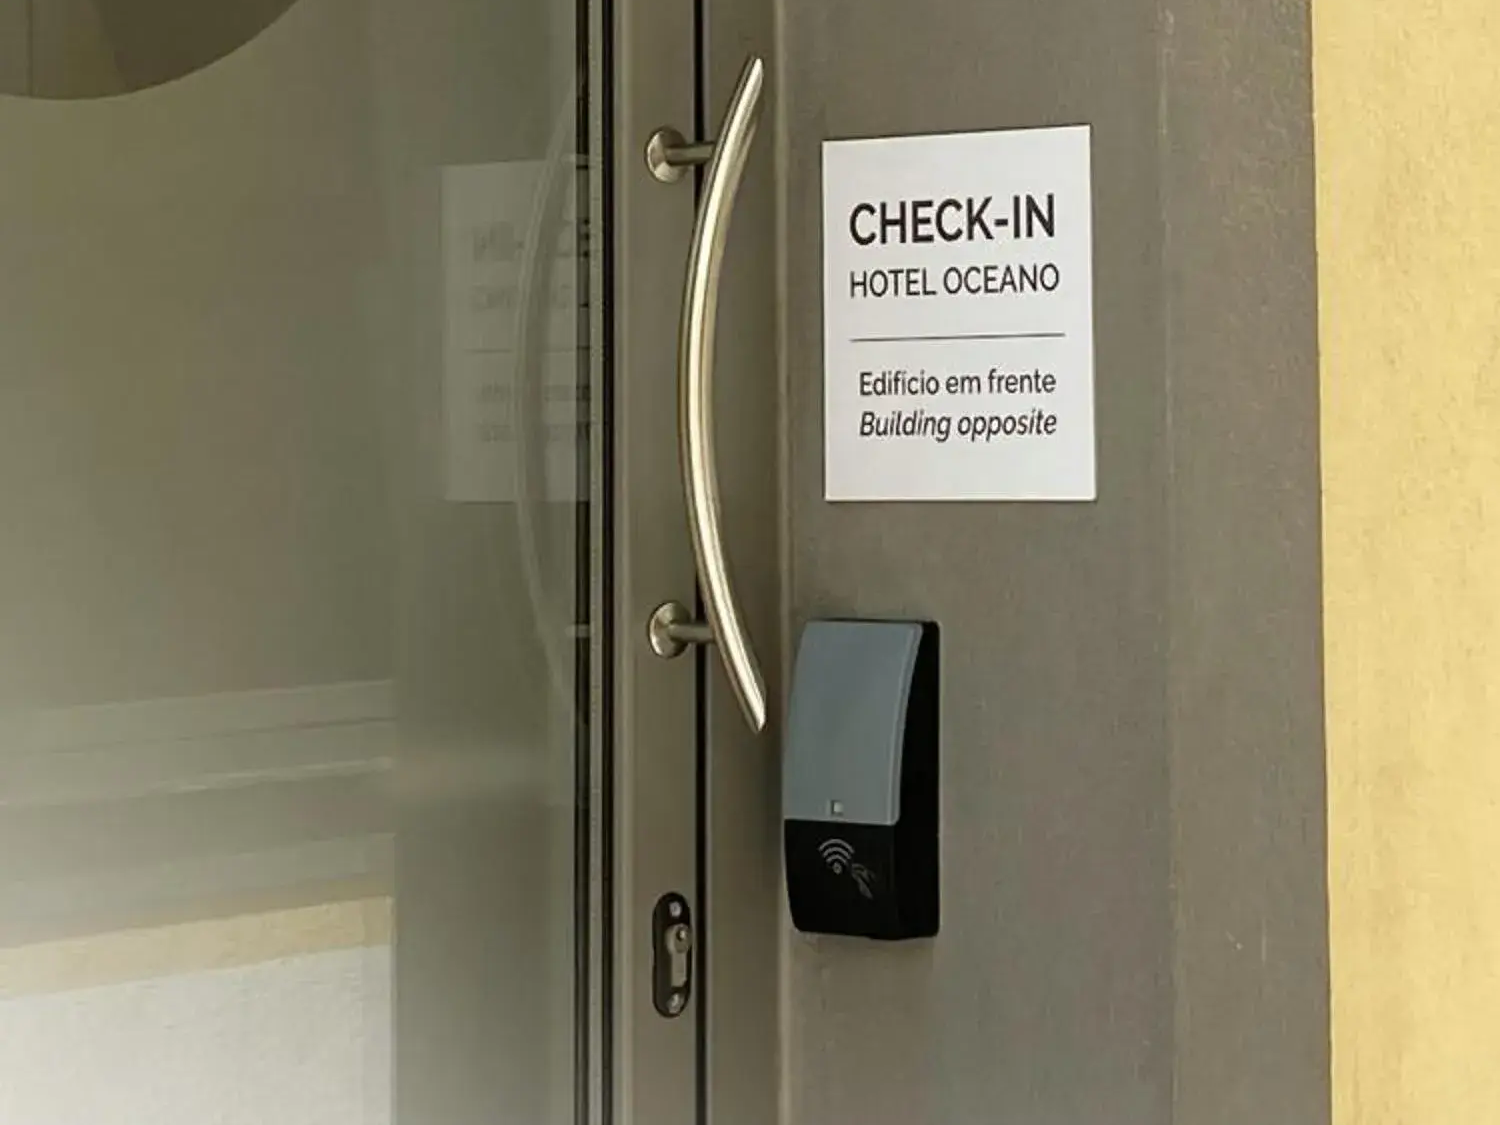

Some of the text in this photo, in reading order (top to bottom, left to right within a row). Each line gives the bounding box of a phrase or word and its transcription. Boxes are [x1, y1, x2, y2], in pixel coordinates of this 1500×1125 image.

[849, 192, 1056, 246] CHECK-IN
[849, 262, 1060, 298] HOTEL OCEANO
[945, 375, 982, 395] em
[987, 368, 1057, 394] frente
[859, 408, 1058, 443] Building opposite
